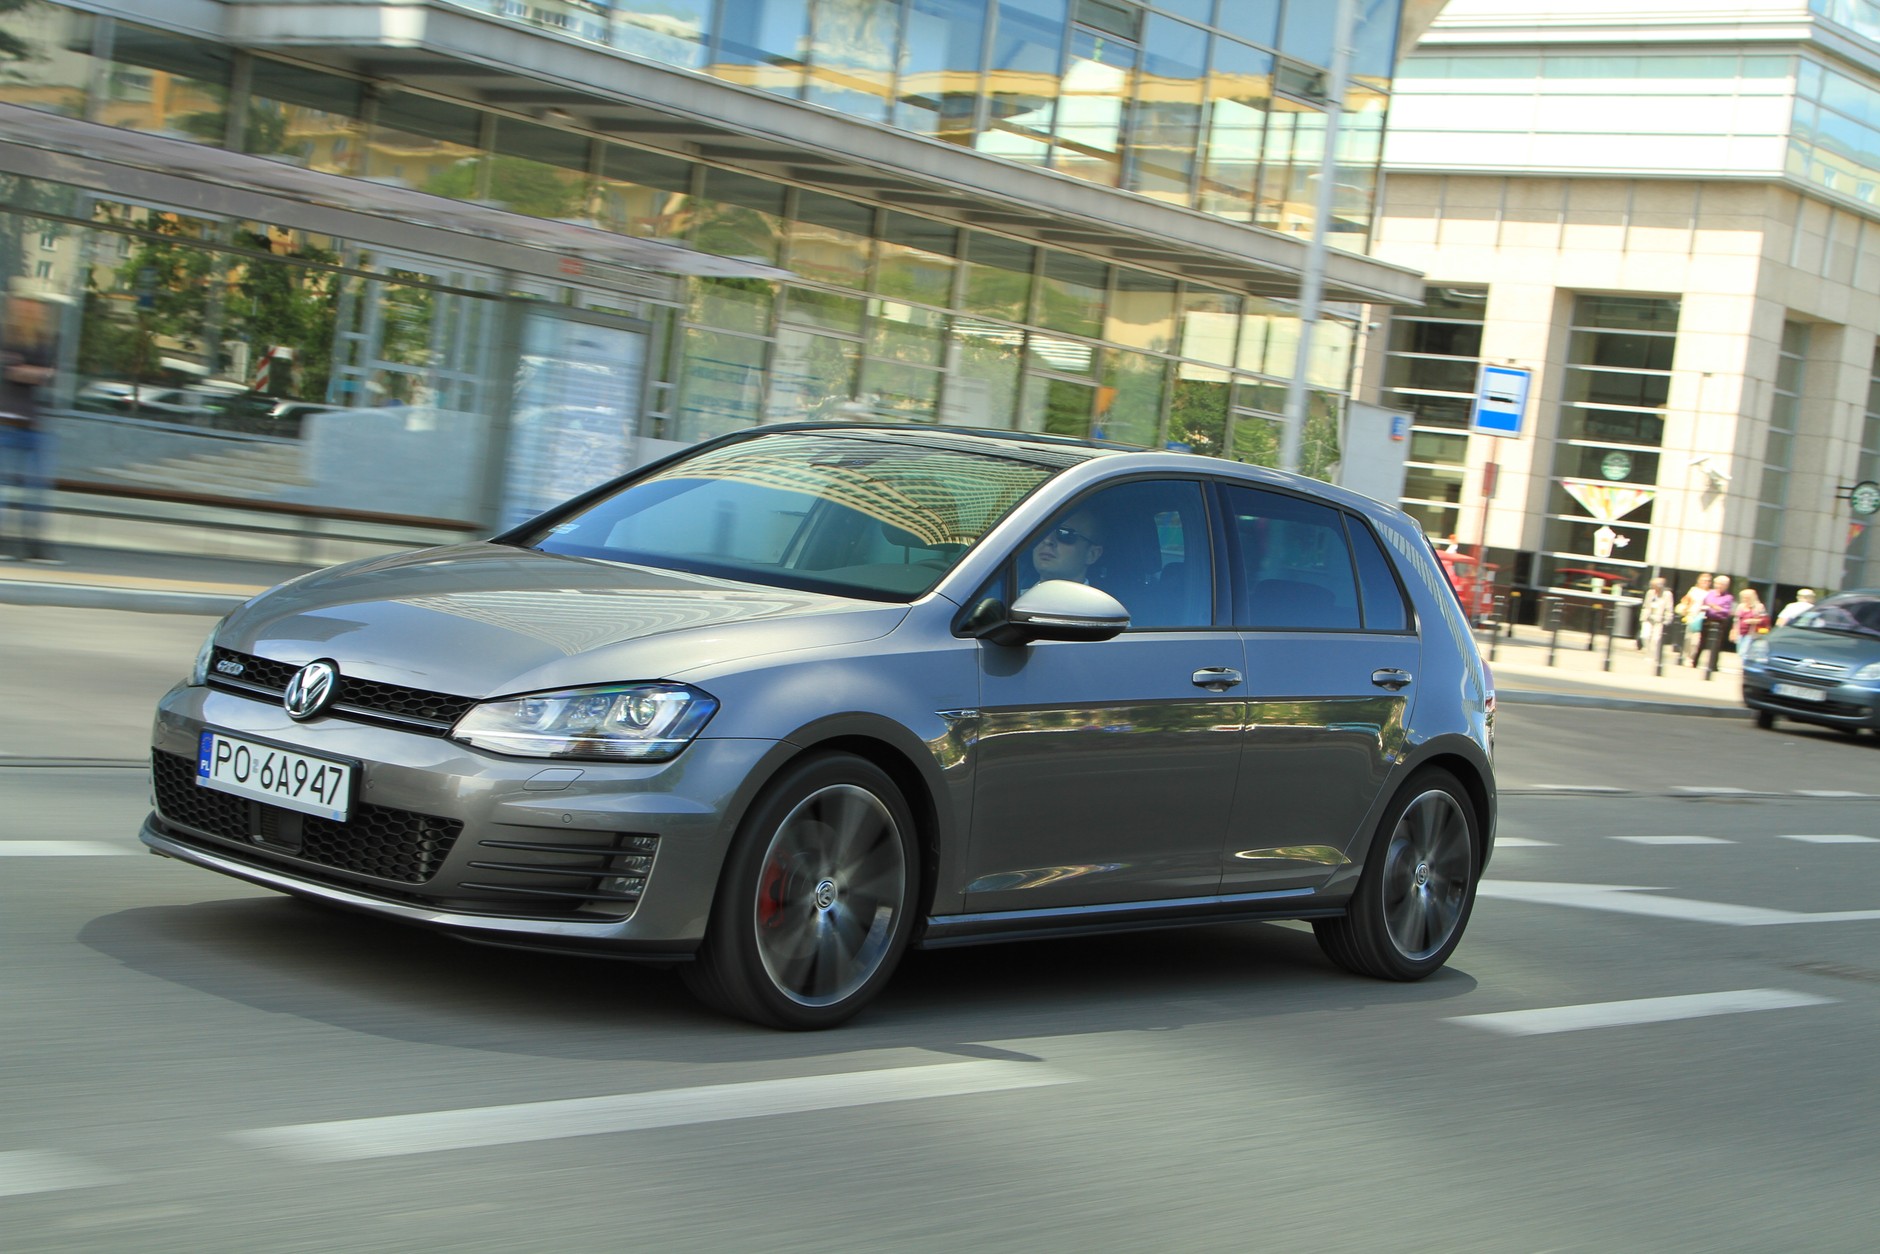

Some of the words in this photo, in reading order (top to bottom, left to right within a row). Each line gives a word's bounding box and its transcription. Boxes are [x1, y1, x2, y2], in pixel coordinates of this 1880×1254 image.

[200, 759, 210, 771] PL
[214, 739, 251, 783] PO
[260, 752, 343, 805] 6A947
